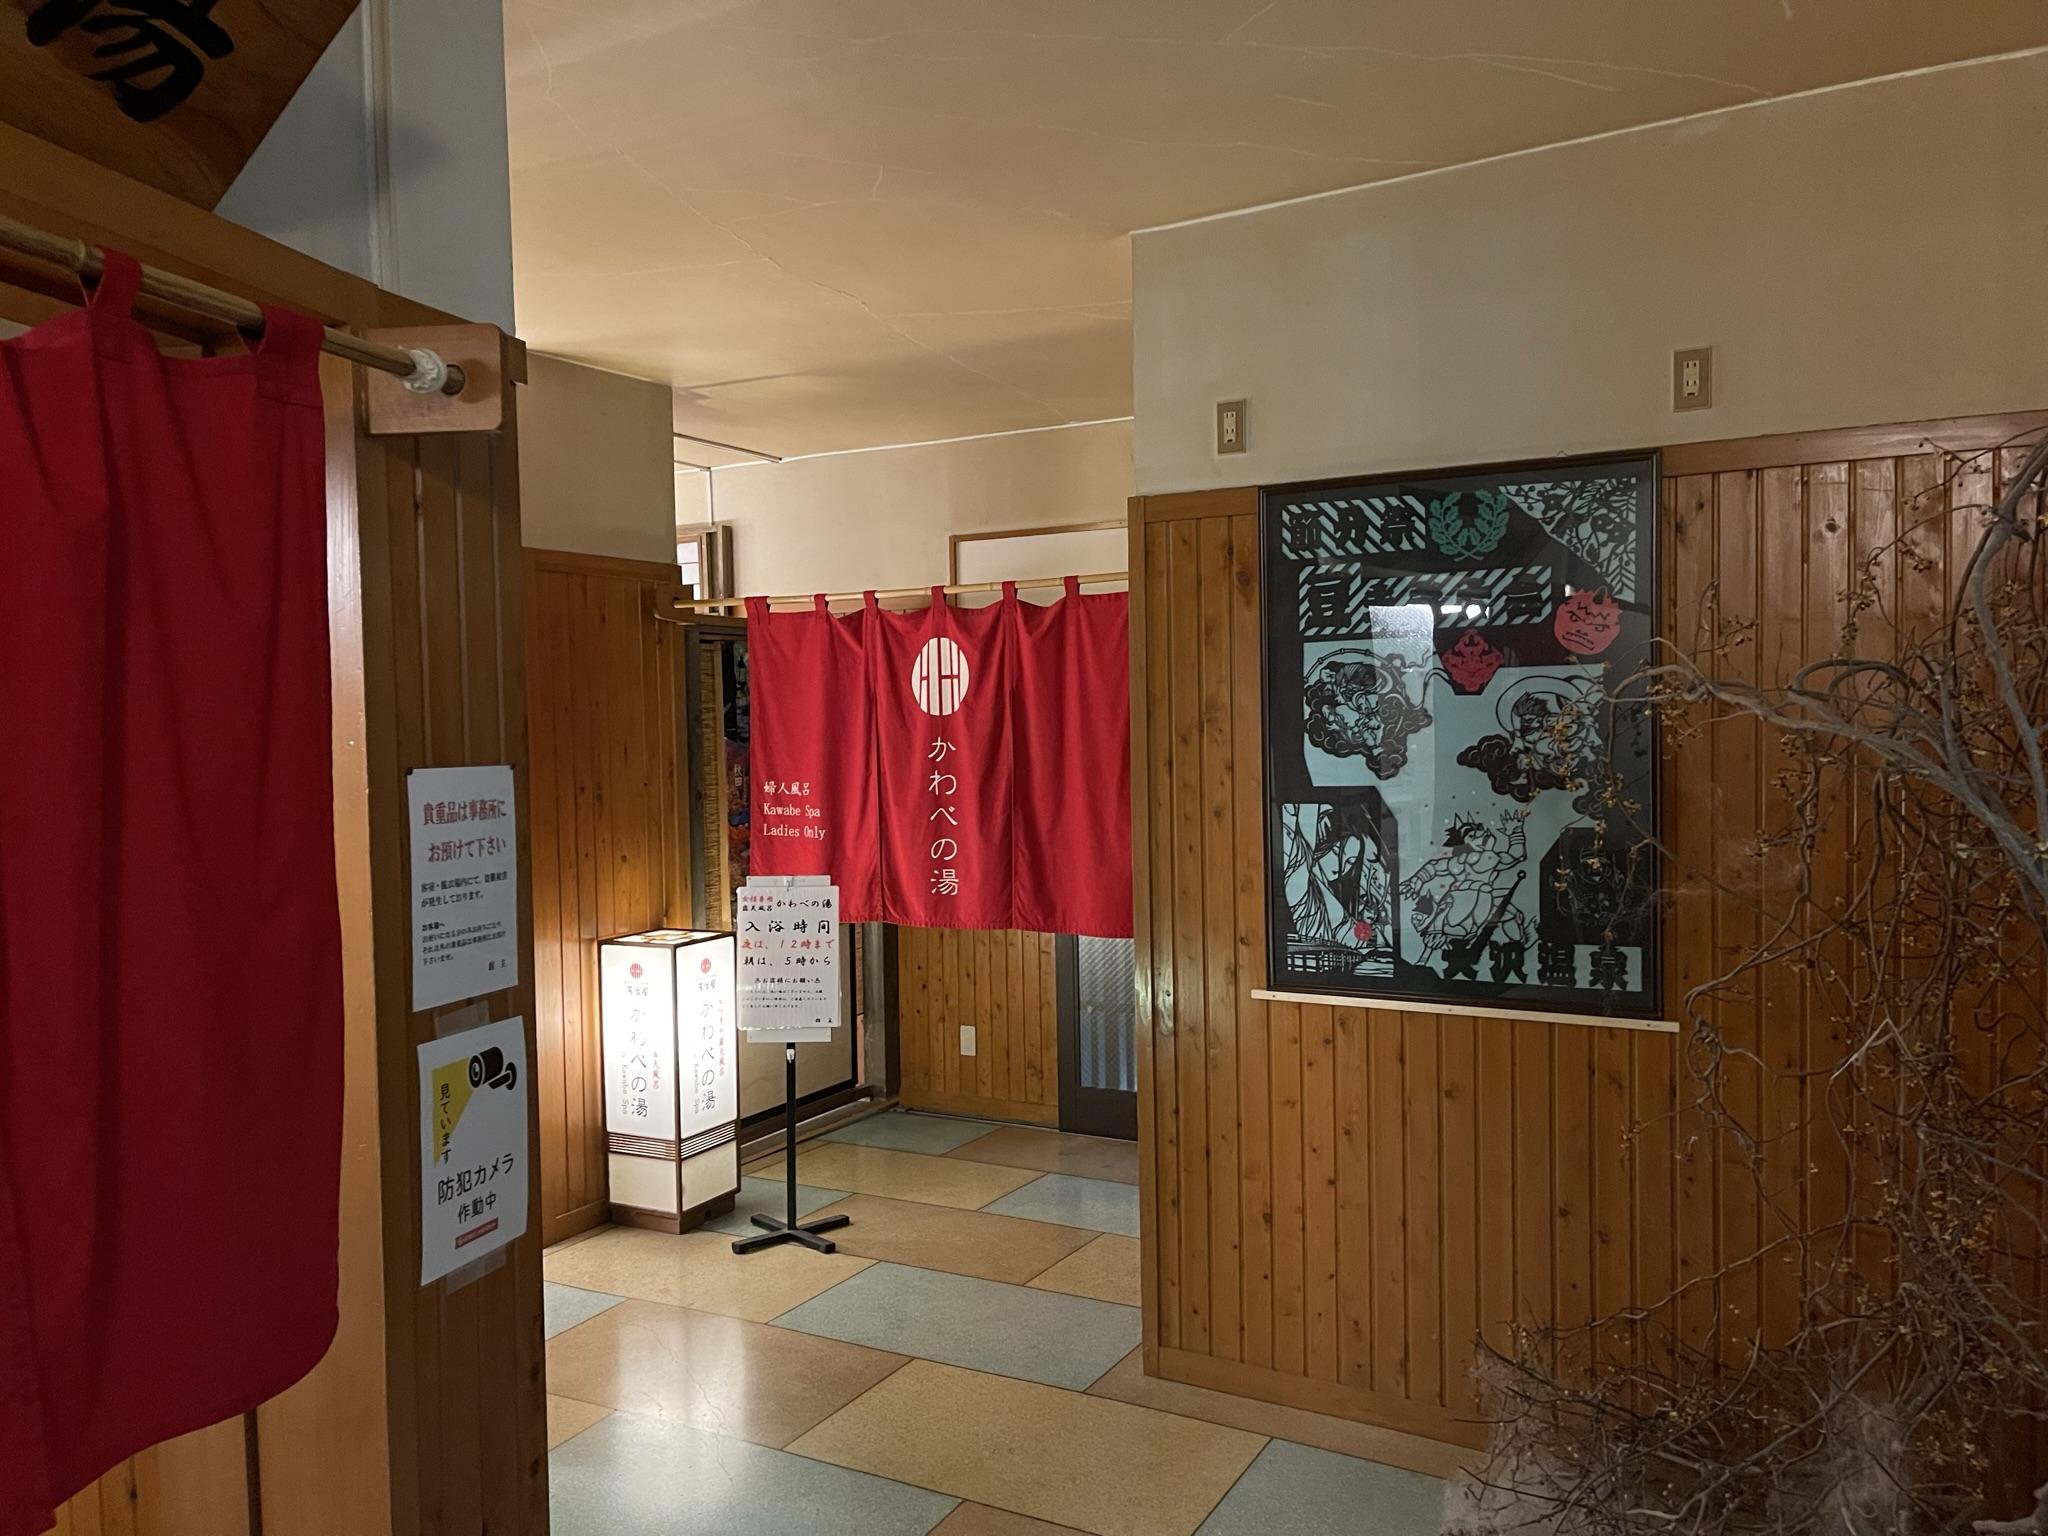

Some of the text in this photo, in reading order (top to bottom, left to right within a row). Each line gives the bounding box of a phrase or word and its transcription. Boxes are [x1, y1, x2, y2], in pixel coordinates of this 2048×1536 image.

[763, 781, 810, 797] 婦人風呂
[423, 799, 507, 826] 貴重品は事務所に
[763, 803, 821, 819] Kawabe Spa
[928, 736, 959, 896] かわべの湯
[763, 824, 826, 841] Ladies Only
[776, 899, 833, 909] かわべの湯
[745, 919, 831, 935] 入浴時間
[630, 1007, 649, 1118] かわべの湯
[700, 1002, 717, 1112] かわべの湯
[440, 1082, 453, 1165] 見ています
[437, 1152, 515, 1206] 防犯カメラ
[457, 1190, 498, 1225] 作動中
